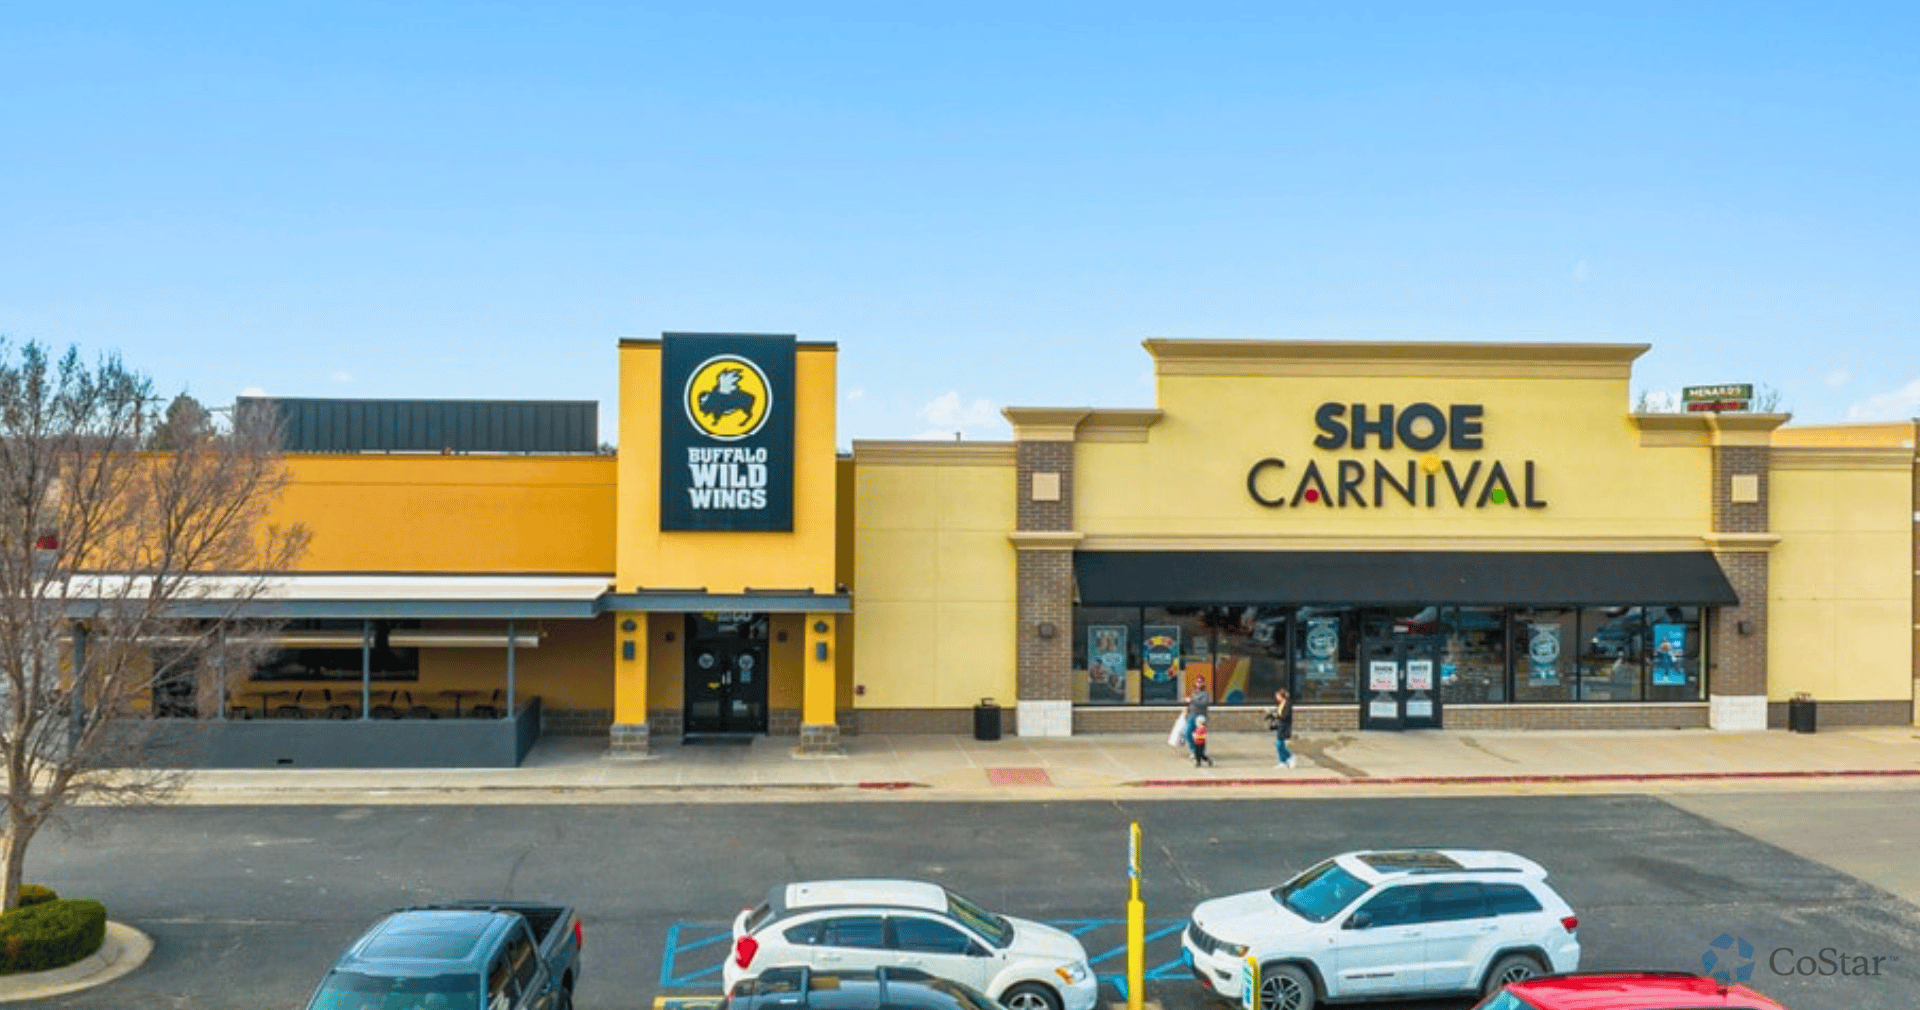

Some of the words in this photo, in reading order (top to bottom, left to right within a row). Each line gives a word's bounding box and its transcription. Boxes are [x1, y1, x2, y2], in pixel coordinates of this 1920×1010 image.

[1313, 402, 1484, 451] SHOE
[687, 447, 768, 463] BUFFALO
[688, 463, 768, 489] WILD
[687, 487, 768, 510] WINGS
